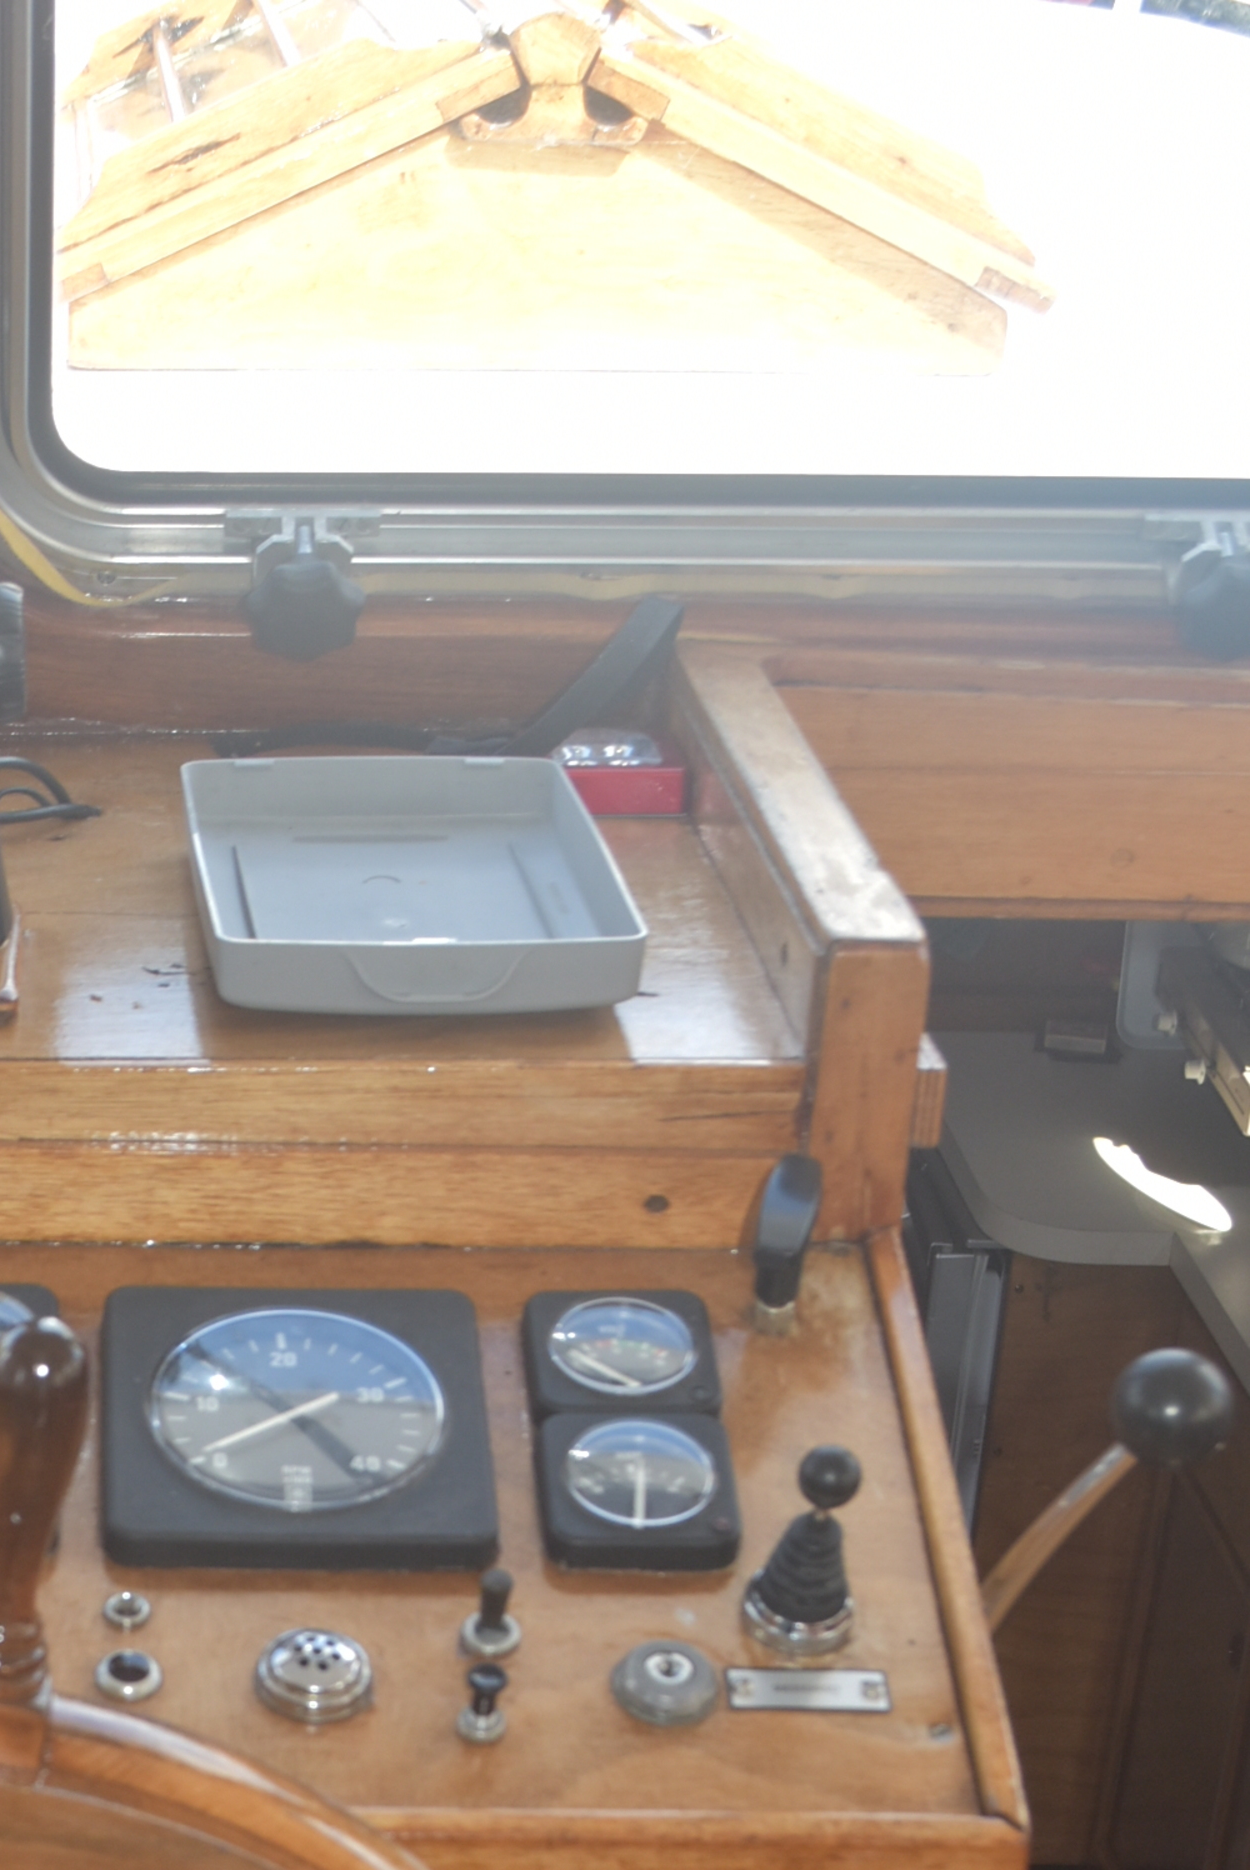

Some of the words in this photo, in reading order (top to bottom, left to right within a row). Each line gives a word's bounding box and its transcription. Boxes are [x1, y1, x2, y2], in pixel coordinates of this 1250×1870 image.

[269, 1352, 298, 1368] 20
[357, 1387, 385, 1403] 30
[196, 1396, 219, 1412] 10
[212, 1452, 228, 1468] 0
[350, 1455, 382, 1472] 40
